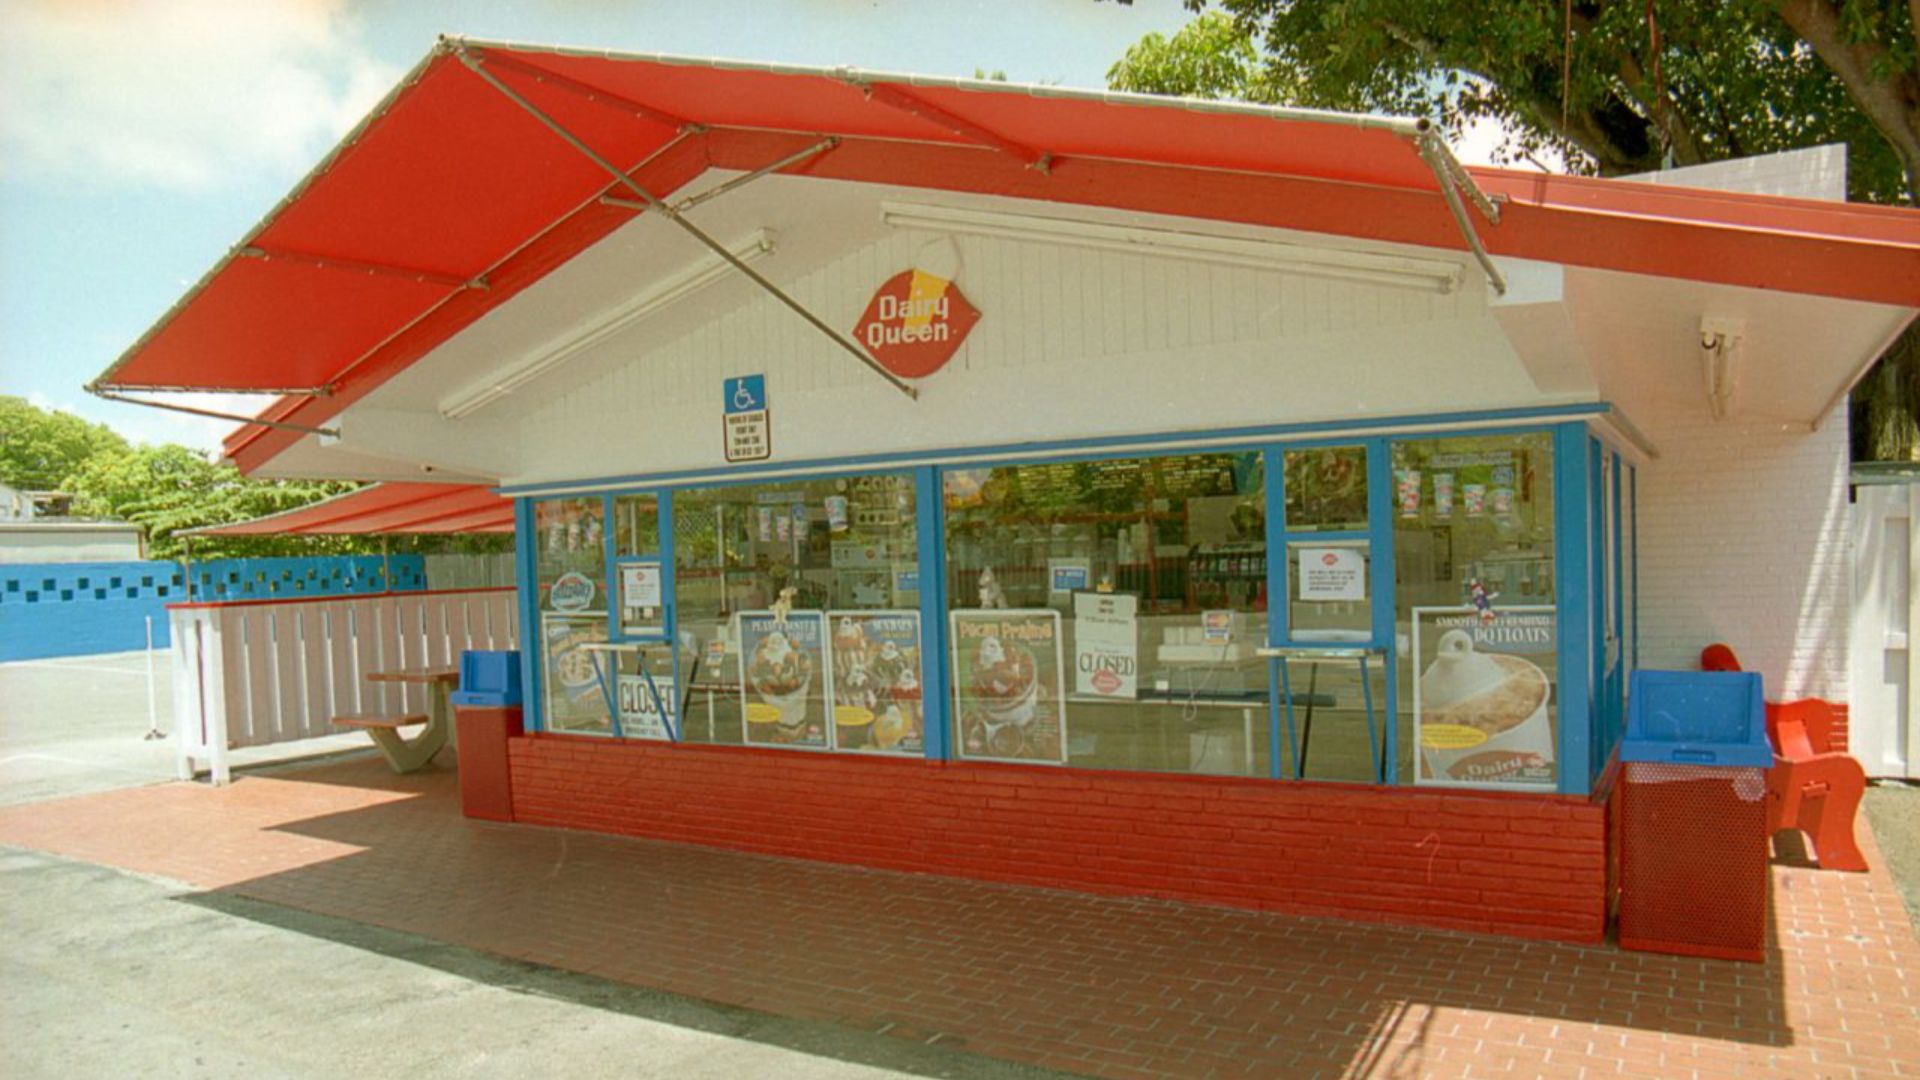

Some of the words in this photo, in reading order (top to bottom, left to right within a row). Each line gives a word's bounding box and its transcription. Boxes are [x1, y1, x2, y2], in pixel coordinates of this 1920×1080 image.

[879, 288, 949, 321] Dairy
[867, 322, 949, 349] Queen
[959, 622, 999, 639] Pecan
[1489, 615, 1550, 627] EFRESHING
[1080, 652, 1135, 676] CLOSED
